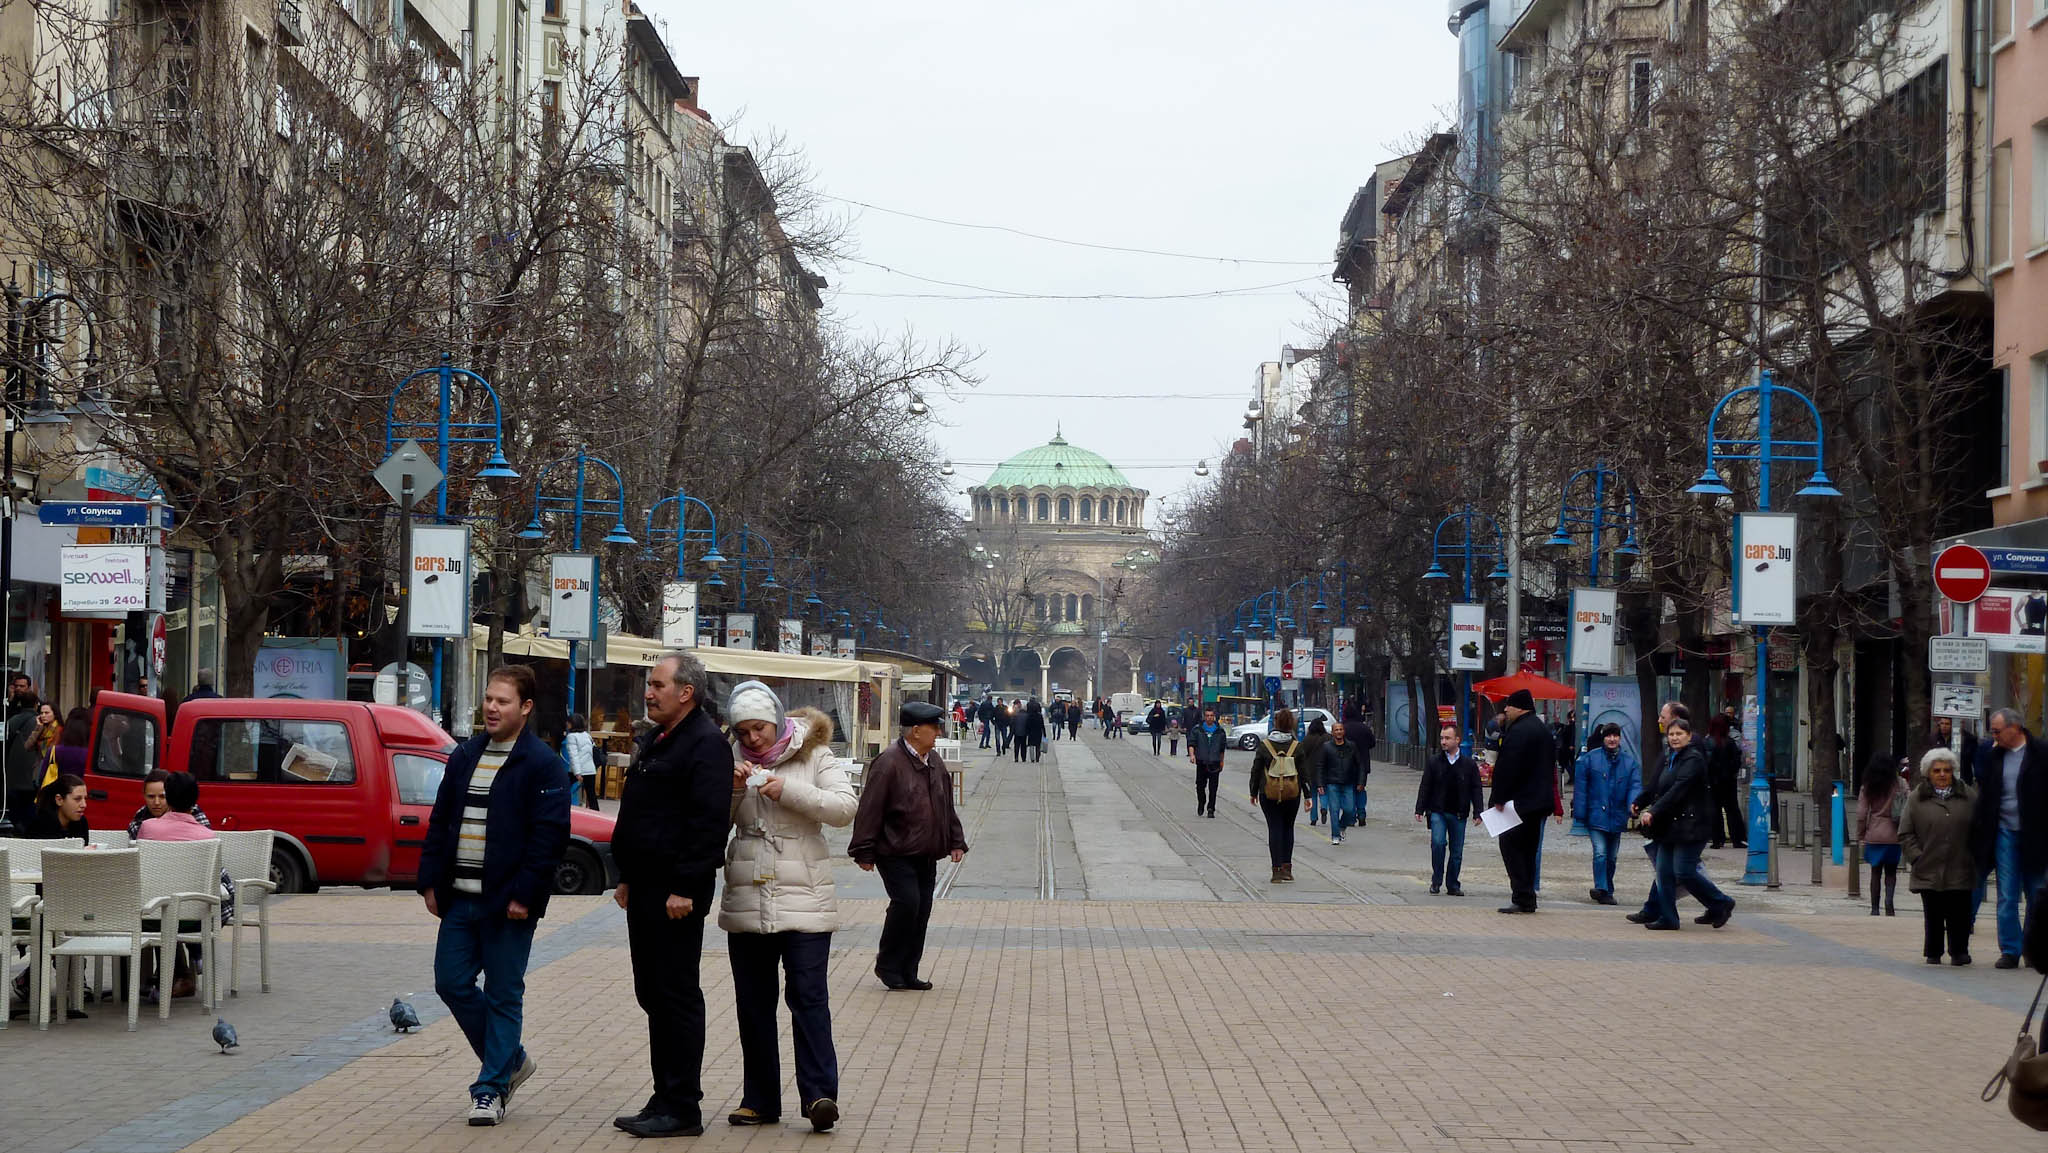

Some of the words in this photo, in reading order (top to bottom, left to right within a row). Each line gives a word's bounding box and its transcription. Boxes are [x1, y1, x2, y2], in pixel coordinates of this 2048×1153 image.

[80, 506, 122, 516] Солунска
[1745, 544, 1791, 562] cars.bg
[2006, 553, 2046, 563] Солунска
[414, 555, 461, 575] cars.bg
[554, 577, 590, 592] cars.bg
[1576, 610, 1612, 626] cars.bg
[728, 629, 751, 638] cars.bg
